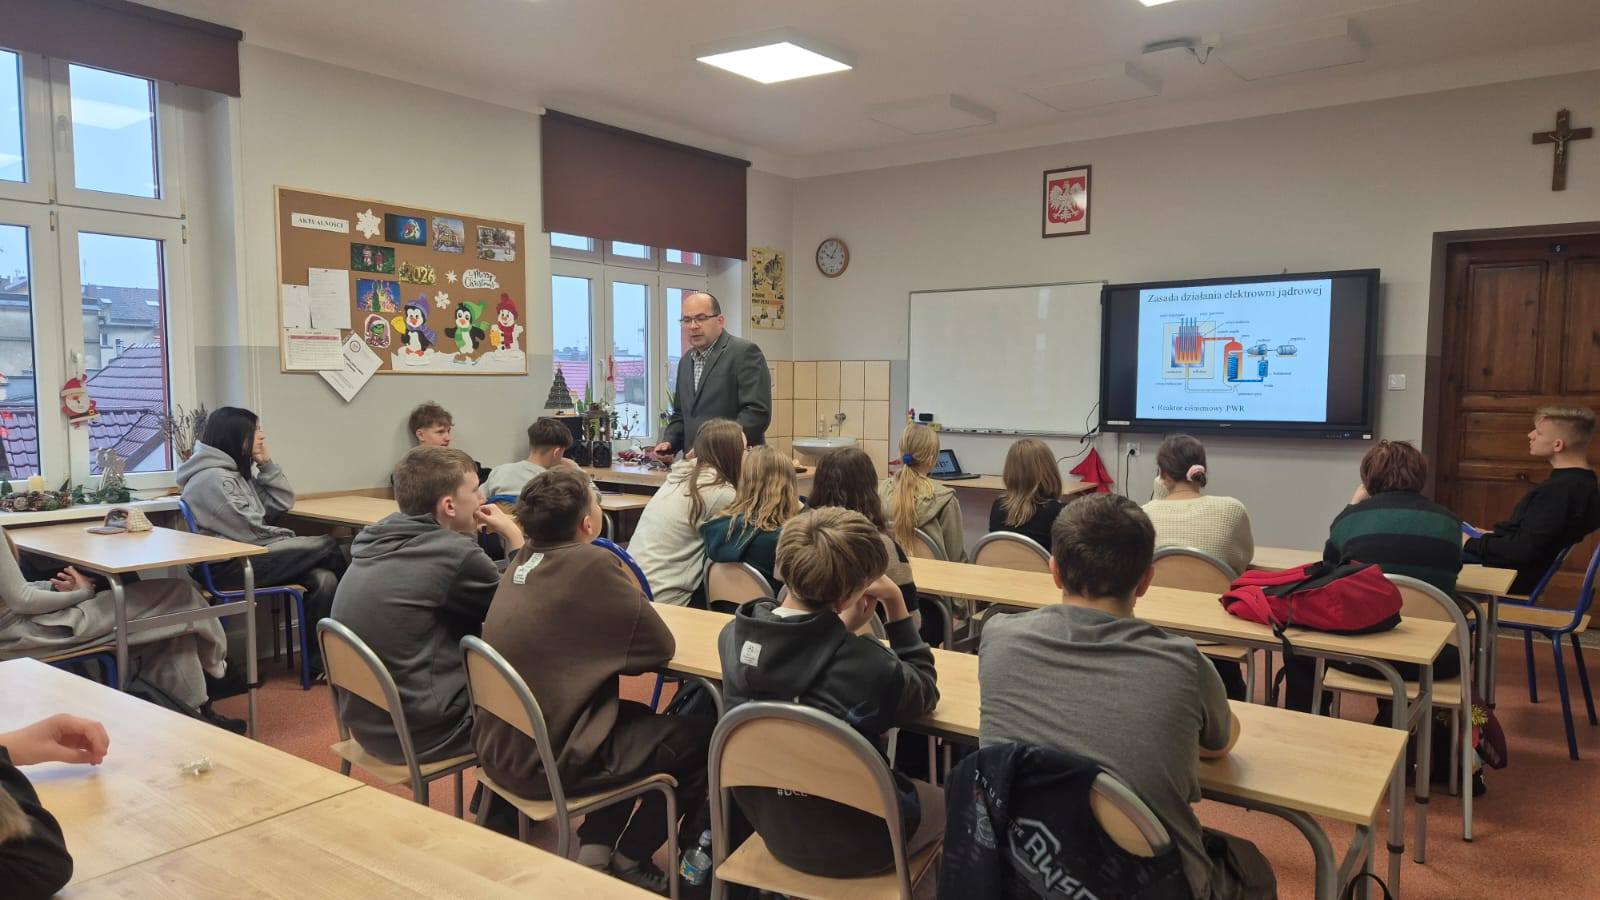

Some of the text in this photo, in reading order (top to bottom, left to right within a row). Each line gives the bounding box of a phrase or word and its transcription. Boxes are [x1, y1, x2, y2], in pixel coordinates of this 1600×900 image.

[1147, 284, 1322, 303] Zasada działania elektrowni jądrowej
[1157, 404, 1183, 412] Reaktor
[1226, 404, 1245, 412] PWR
